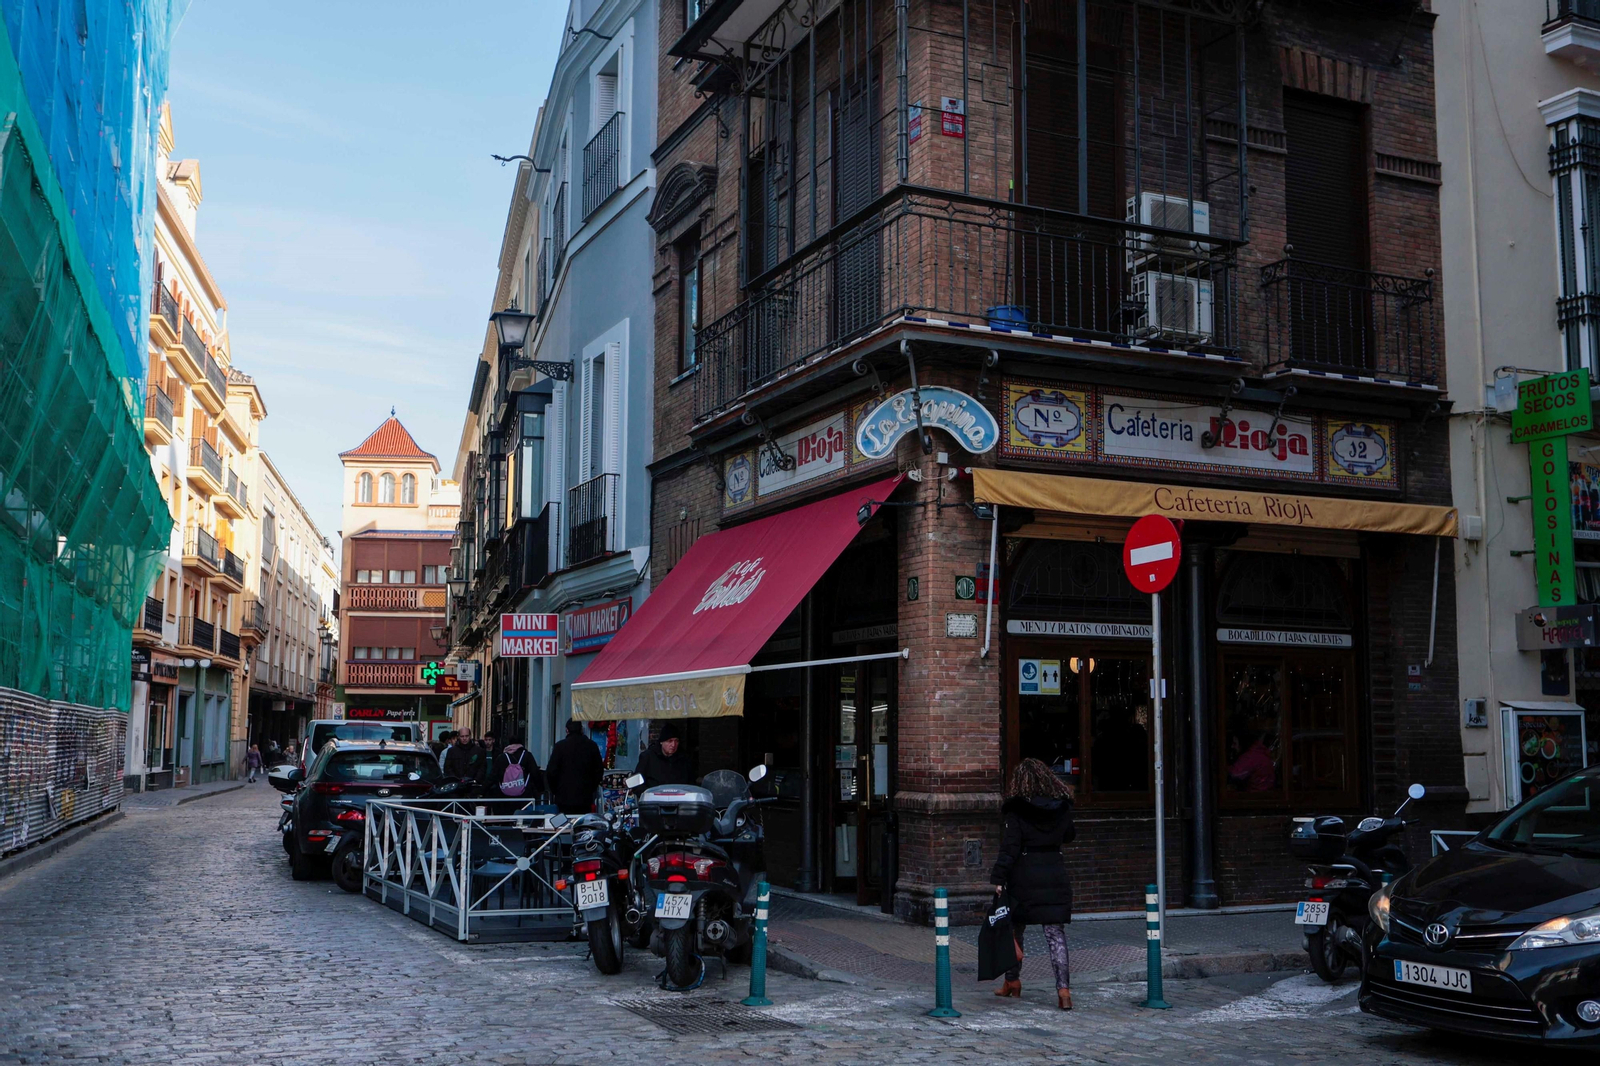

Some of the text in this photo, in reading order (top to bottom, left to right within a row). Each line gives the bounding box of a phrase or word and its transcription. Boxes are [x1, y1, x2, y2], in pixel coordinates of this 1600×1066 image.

[1518, 374, 1580, 400] FRUTOS
[1523, 392, 1576, 414] SECOS
[865, 419, 900, 453] La
[1108, 403, 1309, 461] Cafeteria Rioja
[1514, 415, 1588, 438] CARAMELOS
[798, 426, 844, 467] Rioja
[1154, 487, 1253, 516] Cafetería
[1541, 443, 1562, 602] GOLOSINAS
[512, 615, 548, 630] MINI
[573, 605, 619, 639] MINI MARKET
[1048, 622, 1056, 633] Y
[1058, 622, 1092, 635] PLATOS
[1095, 623, 1150, 636] COMBINADOS
[502, 638, 558, 655] MARKET
[1228, 630, 1343, 645] BOCADILLOS Y TAPAS CALIENTES
[580, 881, 603, 893] B-LV
[581, 892, 605, 905] 2018
[665, 896, 689, 906] 4574
[1304, 903, 1327, 913] 2853
[663, 906, 682, 916] HTX
[1302, 913, 1320, 923] JLT
[1406, 964, 1467, 989] 1304 JJC
